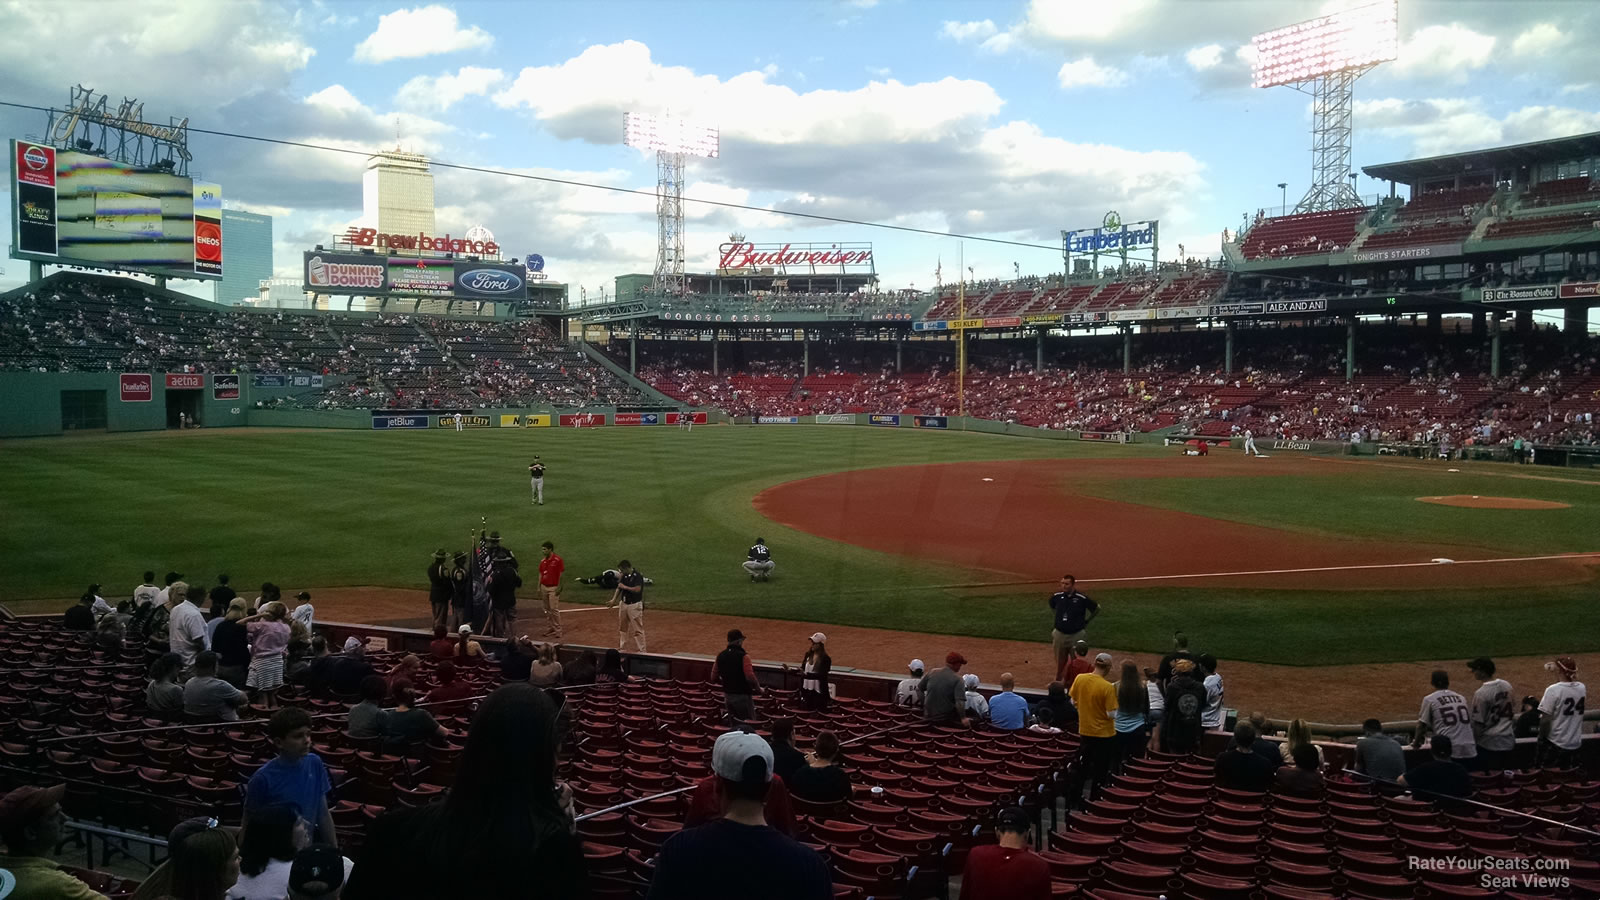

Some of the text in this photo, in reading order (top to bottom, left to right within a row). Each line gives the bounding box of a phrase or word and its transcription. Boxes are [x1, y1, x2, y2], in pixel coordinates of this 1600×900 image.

[51, 84, 192, 162] John Hancock
[26, 154, 46, 163] NISSAN
[197, 236, 220, 246] ENEOS
[377, 232, 498, 255] new balance
[1066, 222, 1153, 252] Cumberland
[719, 243, 872, 269] Budweiser
[1353, 248, 1430, 261] TONIGHT'S STARTERS
[330, 264, 383, 278] DUNKIN'
[330, 274, 380, 287] DONUTS
[472, 272, 510, 291] Ford
[1510, 290, 1533, 298] Boston
[1534, 288, 1553, 297] Globe
[1269, 301, 1324, 312] ALEX AND ANI
[171, 377, 198, 386] aetna
[387, 417, 415, 427] jetBlue
[473, 416, 489, 425] CITY
[1437, 695, 1462, 706] BETTS
[1563, 696, 1586, 716] 24
[1438, 706, 1470, 726] 50
